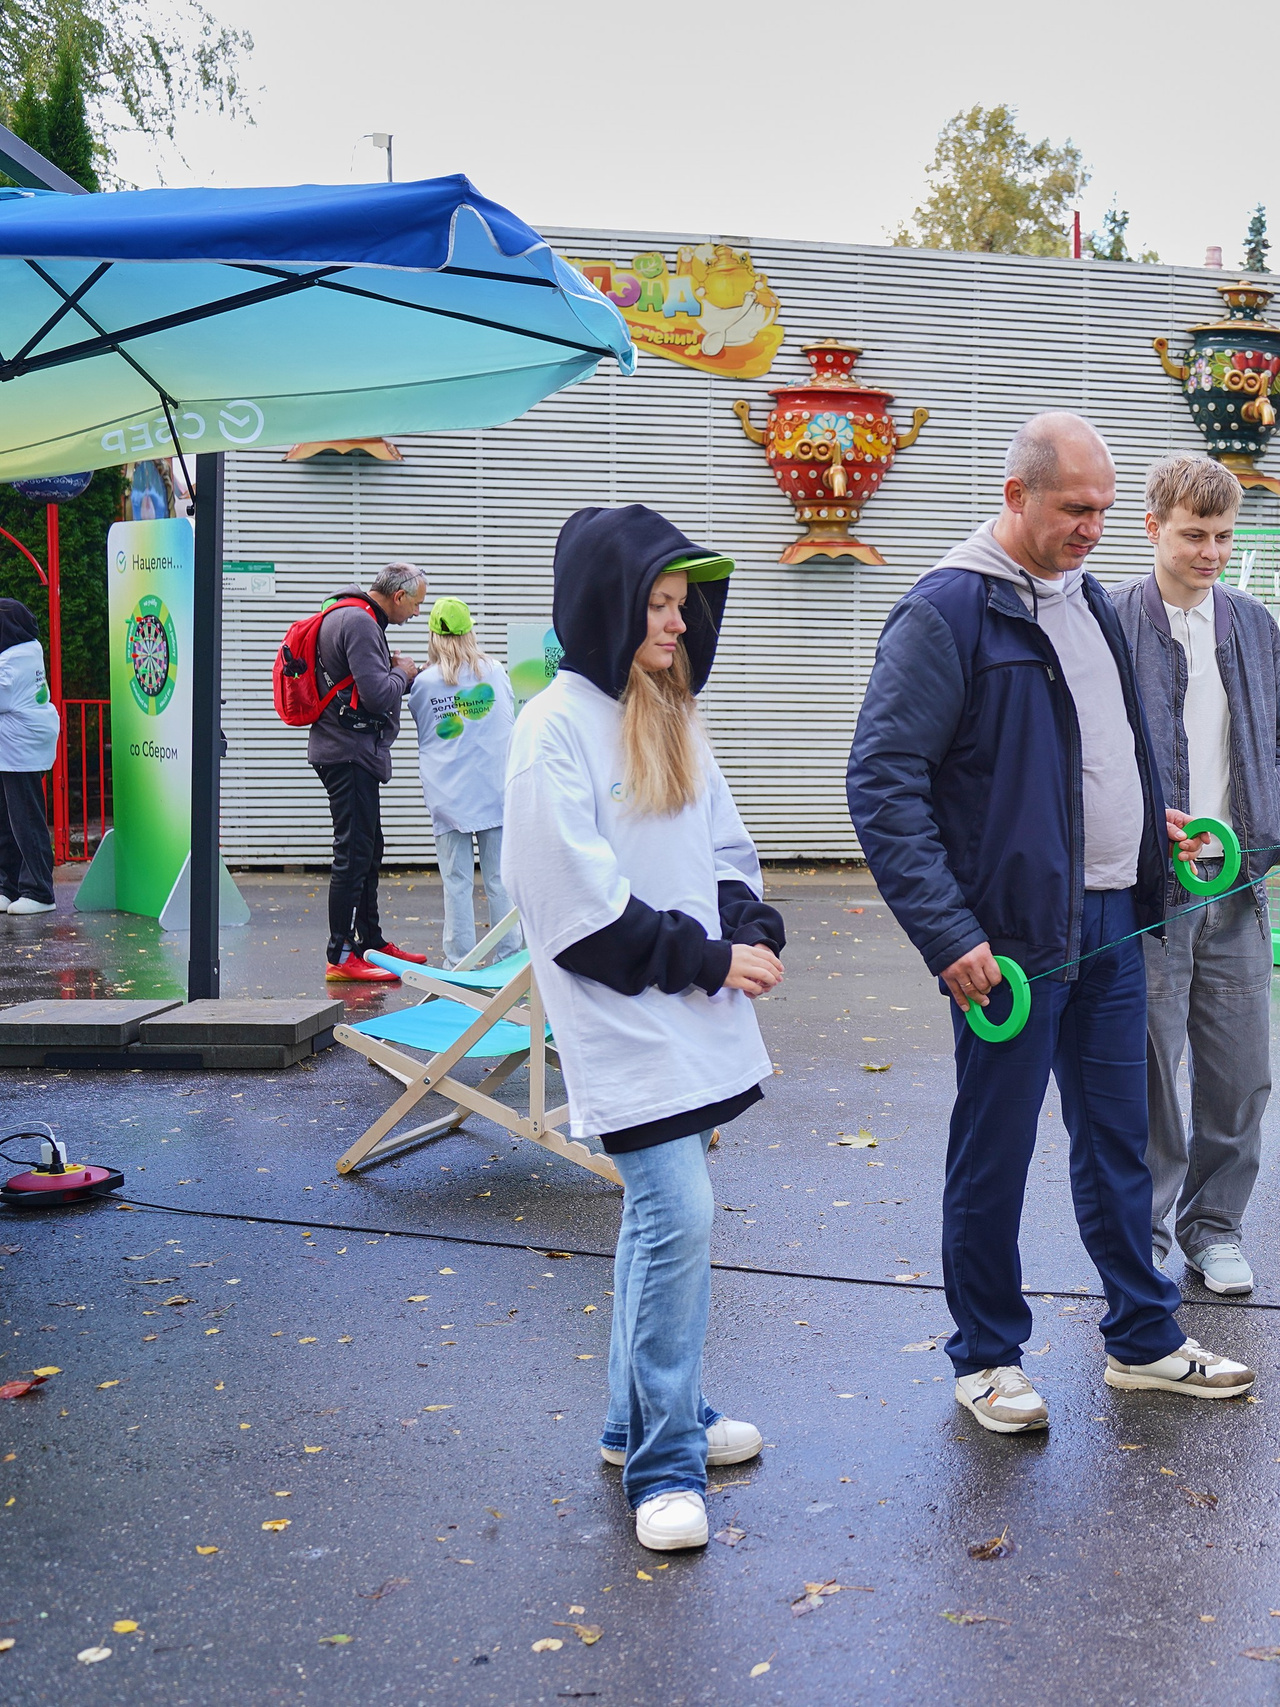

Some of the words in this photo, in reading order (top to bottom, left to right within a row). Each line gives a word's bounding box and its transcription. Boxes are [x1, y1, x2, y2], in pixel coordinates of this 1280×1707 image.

[430, 695, 461, 706] Быть
[432, 699, 485, 713] зелёным
[462, 706, 490, 716] рядом
[130, 742, 141, 756] со
[142, 740, 178, 763] Сбером
